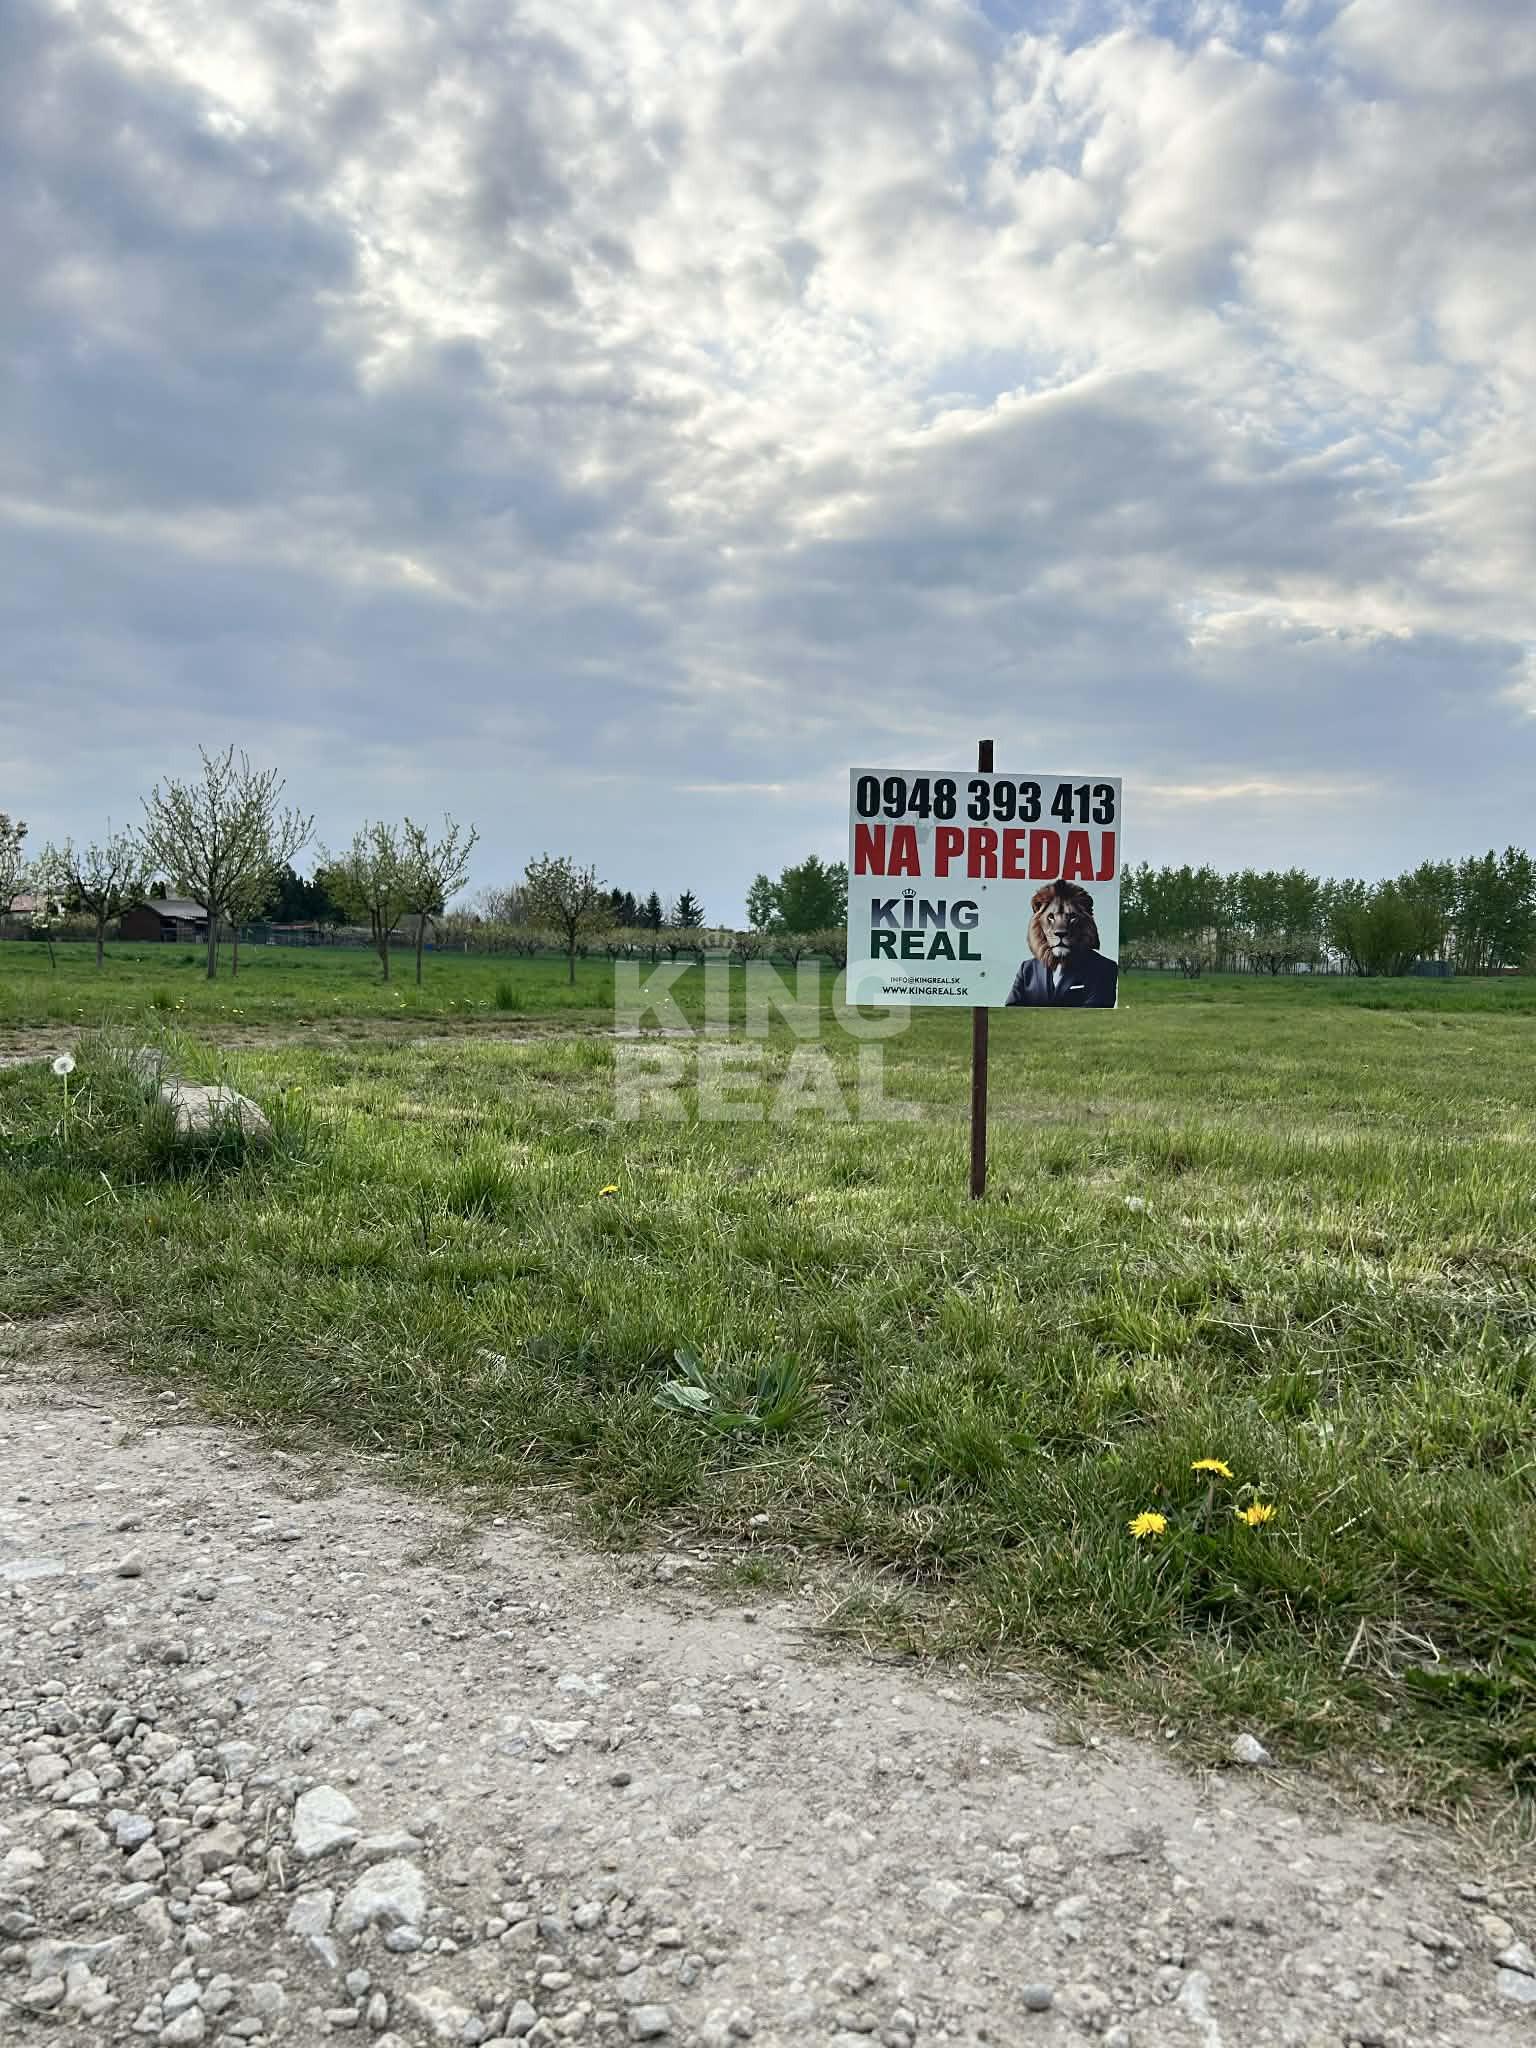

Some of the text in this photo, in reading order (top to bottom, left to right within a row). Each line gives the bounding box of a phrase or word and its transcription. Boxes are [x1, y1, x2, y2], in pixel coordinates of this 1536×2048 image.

[857, 776, 1115, 824] 0948 393 413
[855, 824, 1115, 881] NA PREDAJ
[871, 898, 979, 930] KING
[870, 930, 982, 961] REAL
[882, 986, 969, 996] WWW.KINGREAL.SK
[890, 976, 961, 985] INFO@KINGREAL.SK
